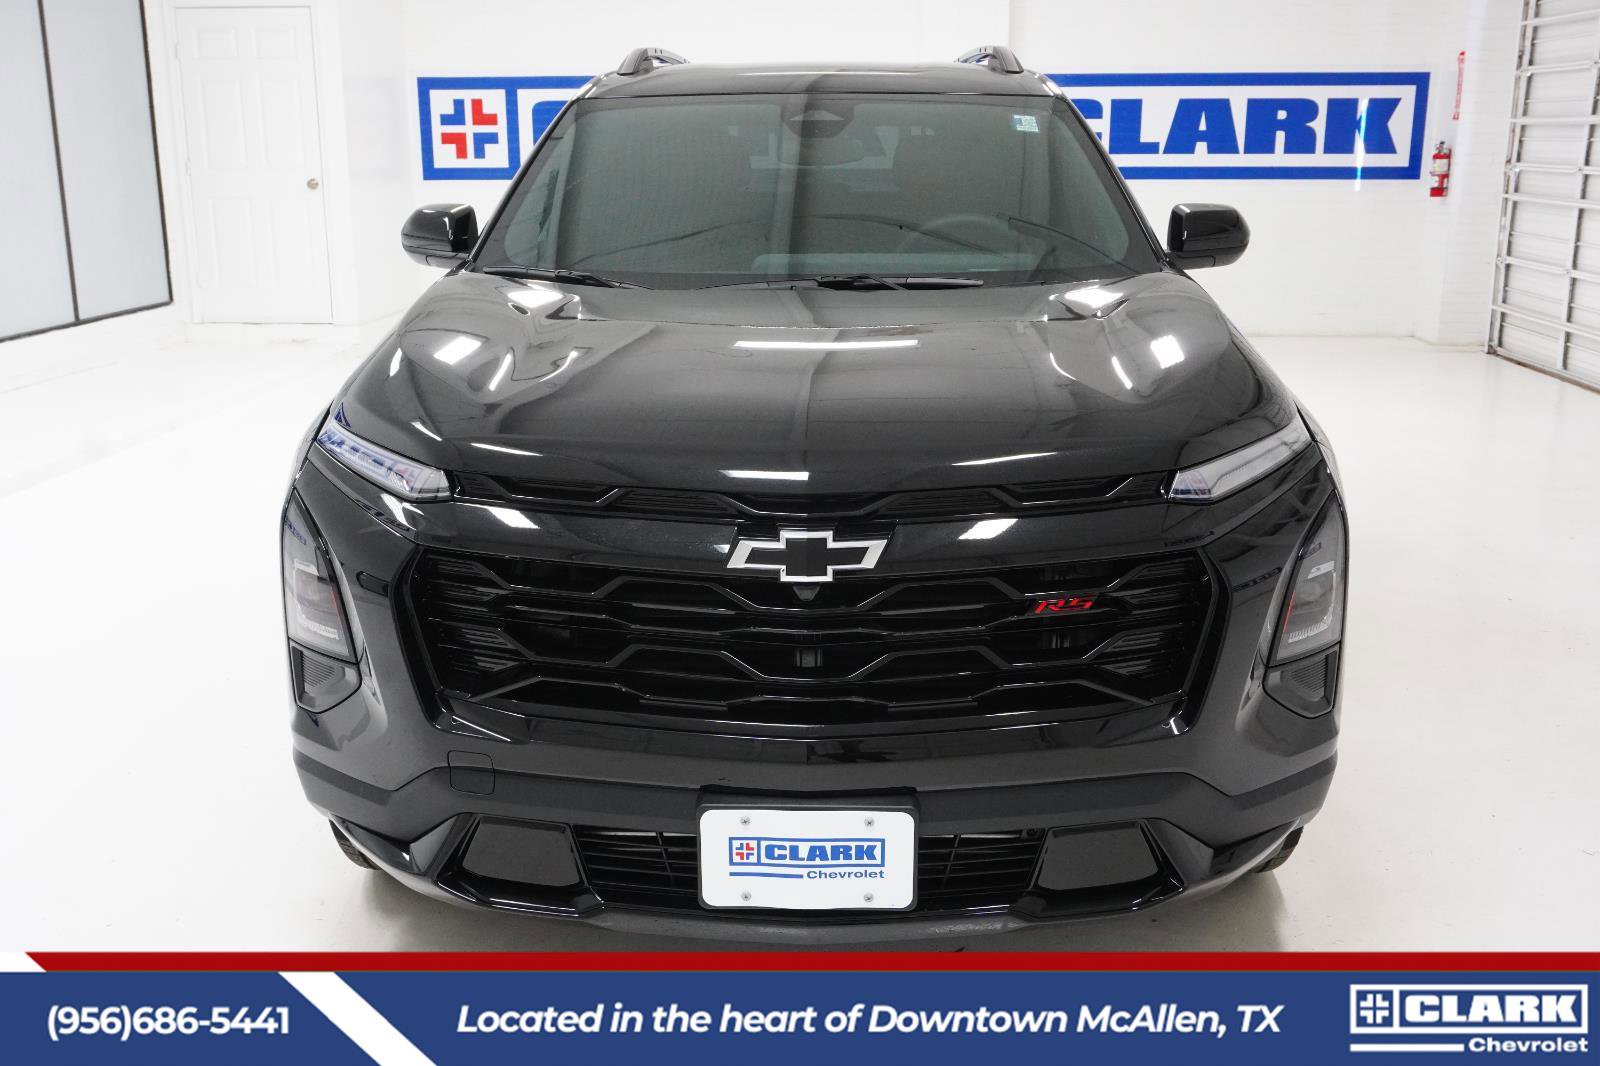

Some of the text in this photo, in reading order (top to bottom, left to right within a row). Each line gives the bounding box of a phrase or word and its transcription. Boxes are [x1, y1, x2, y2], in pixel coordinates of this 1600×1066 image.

[1034, 594, 1096, 614] RS
[764, 843, 877, 862] CLARK
[806, 869, 885, 879] Chevrolet
